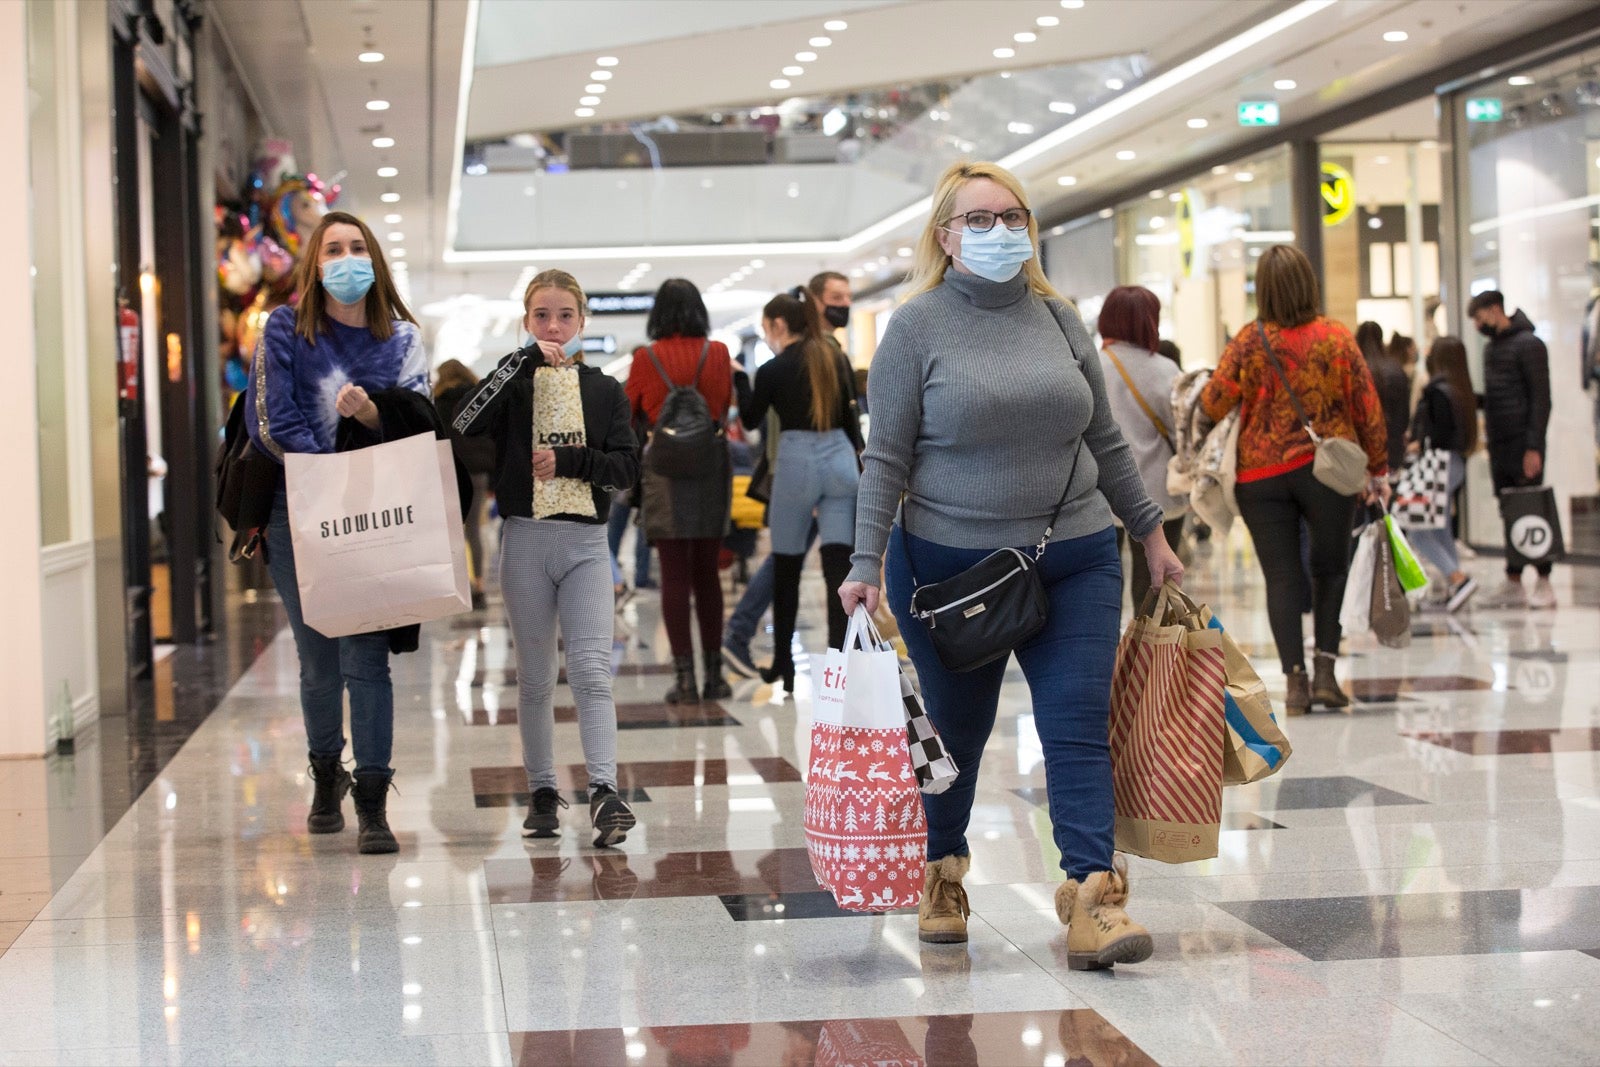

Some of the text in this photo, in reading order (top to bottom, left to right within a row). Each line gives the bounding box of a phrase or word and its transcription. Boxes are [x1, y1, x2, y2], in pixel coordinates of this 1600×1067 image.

[489, 364, 516, 393] SIKSILK
[454, 401, 482, 432] SIKSILK
[1518, 527, 1546, 547] JD
